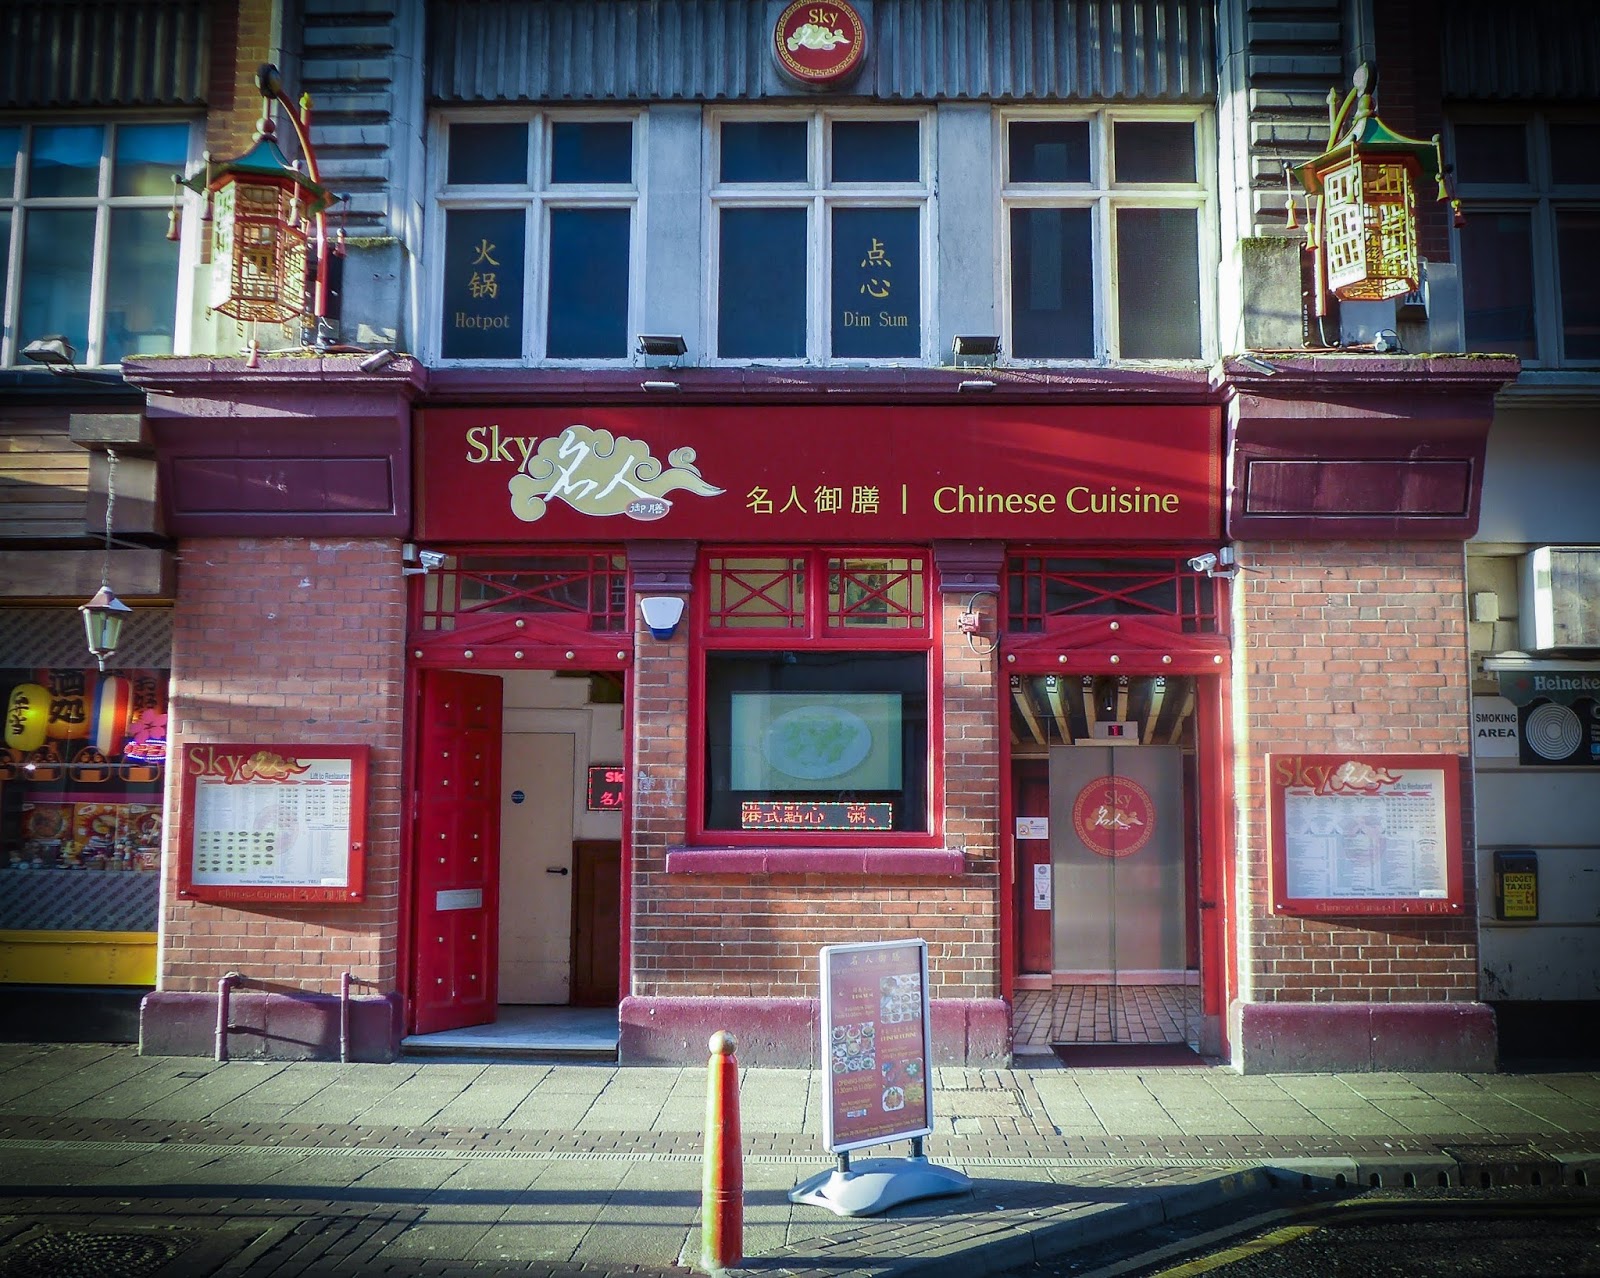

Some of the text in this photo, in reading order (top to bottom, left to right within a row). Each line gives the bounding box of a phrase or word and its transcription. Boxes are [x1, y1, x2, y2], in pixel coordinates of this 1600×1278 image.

[809, 9, 838, 27] Sky
[468, 239, 500, 299] 火锅
[860, 238, 892, 298] 点心
[455, 312, 510, 330] Hotpot
[844, 311, 908, 327] Dim Sum
[465, 425, 538, 473] Sky
[746, 485, 880, 514] 名人御膳
[933, 484, 1056, 514] Chinese
[1066, 486, 1180, 514] Cuisine
[1534, 675, 1600, 690] Heineke
[1476, 713, 1517, 723] SMOKING
[1478, 728, 1516, 738] AREA
[189, 746, 243, 783] Sky
[1275, 757, 1333, 794] Sky
[1104, 790, 1132, 807] Sky
